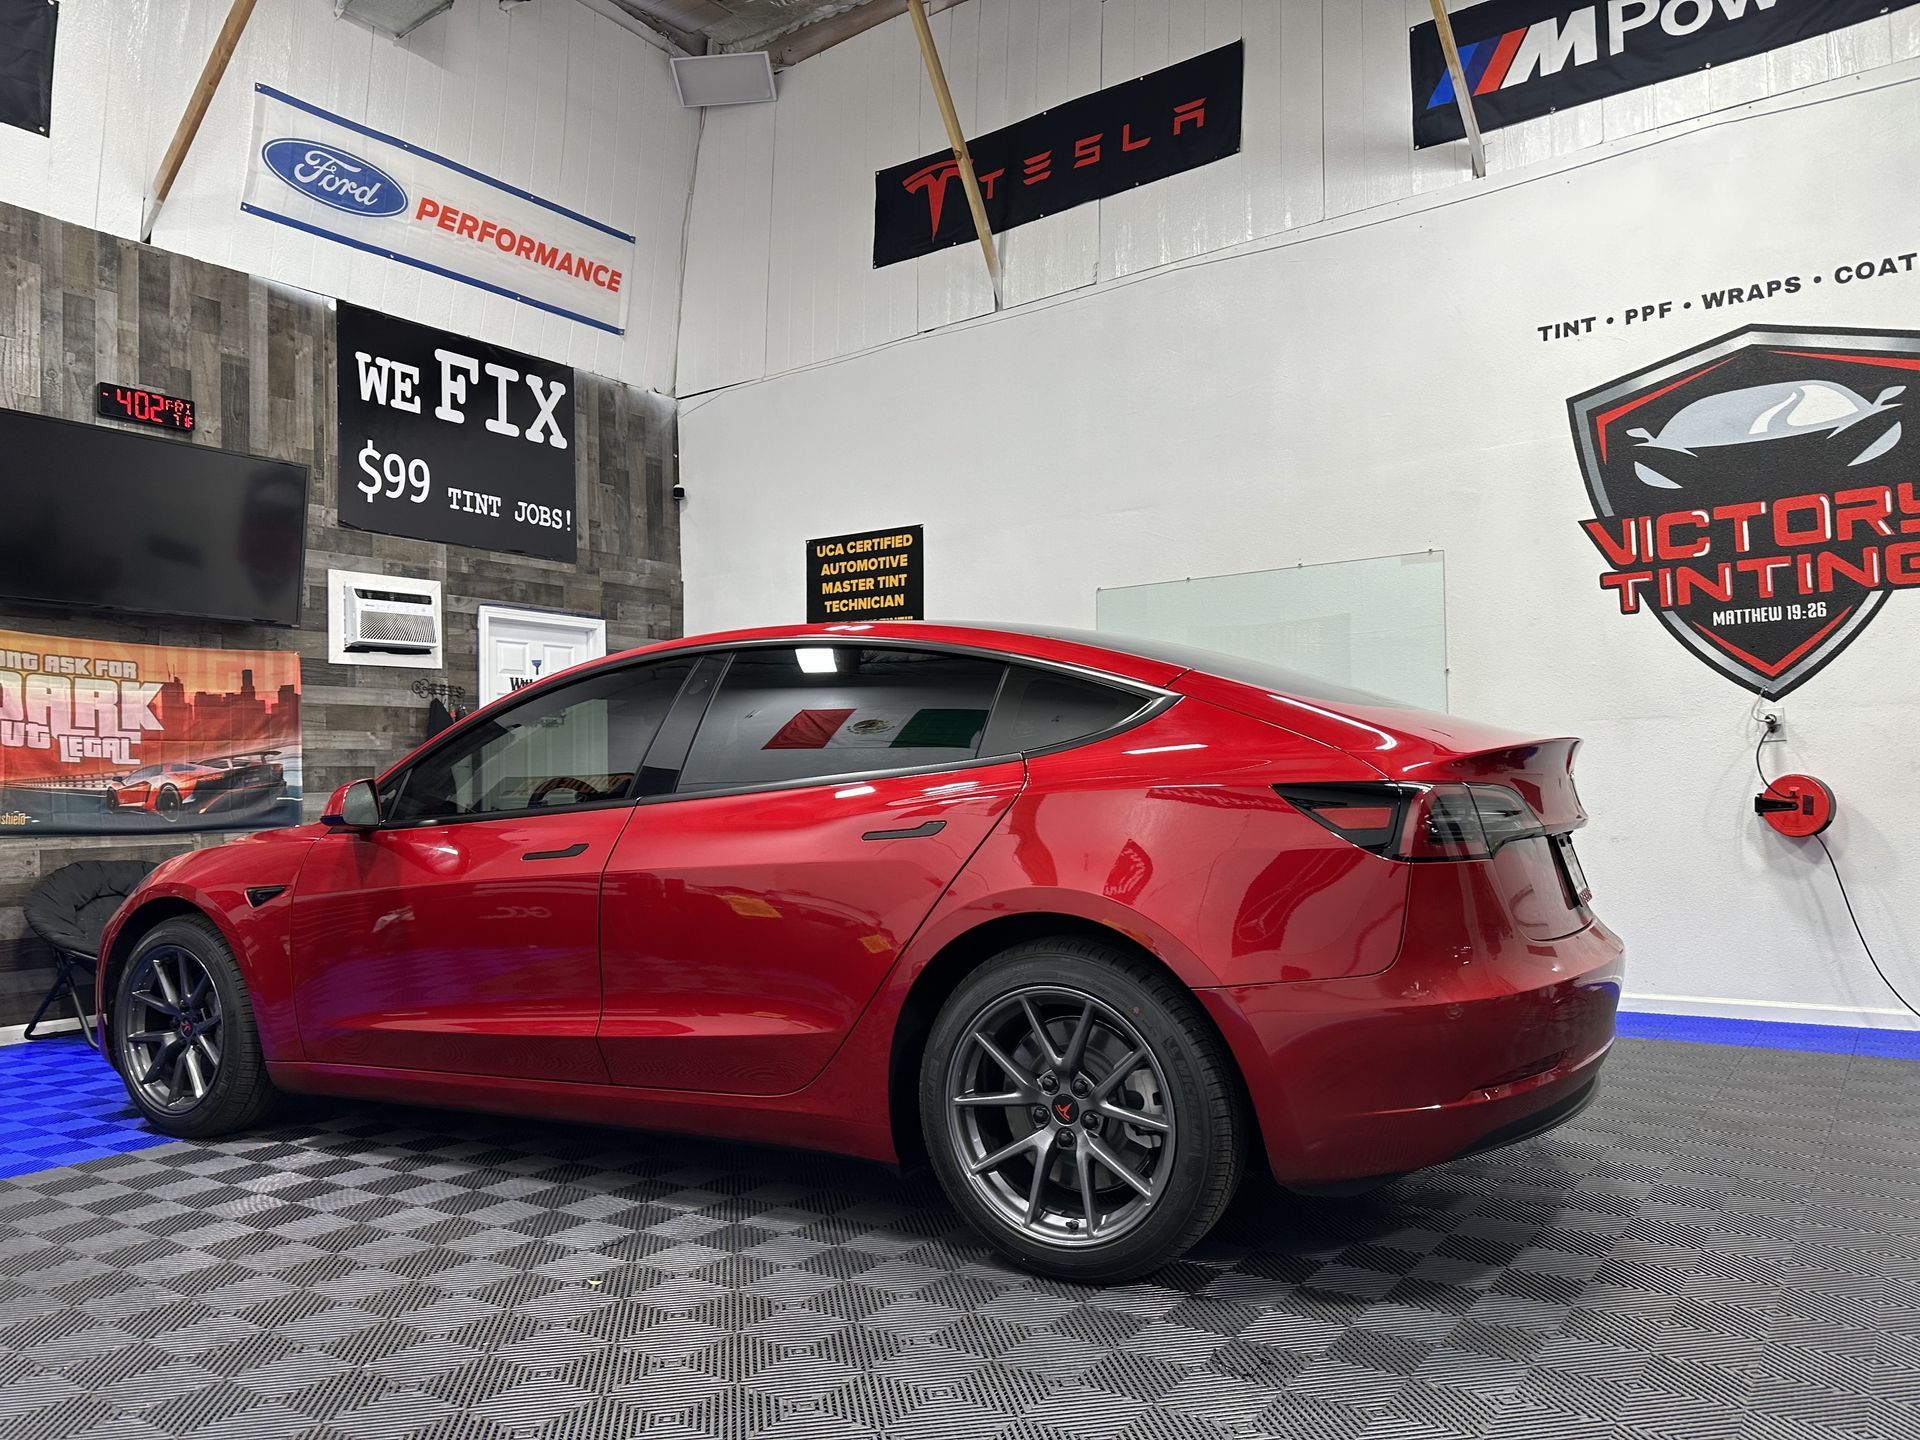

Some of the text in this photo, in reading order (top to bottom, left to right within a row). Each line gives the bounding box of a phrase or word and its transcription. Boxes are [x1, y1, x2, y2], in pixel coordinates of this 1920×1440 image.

[978, 97, 1206, 200] TESLA
[294, 150, 622, 293] Ford PERFORMANCE
[1537, 317, 1596, 342] TINT
[1625, 301, 1673, 325] PPF
[1701, 276, 1802, 310] WRAPS
[355, 348, 568, 450] WE FIX
[357, 439, 571, 531] $99 TINT JOBS!
[816, 534, 913, 558] UCA CERTIFIED
[820, 554, 908, 577] AUTOMOTIVE
[822, 573, 908, 595] MASTER TINT
[824, 593, 905, 613] TECHNICIAN
[1712, 601, 1827, 627] MATTHEW 19:26
[44, 655, 91, 676] ASK
[95, 659, 138, 679] FOR
[59, 735, 141, 765] LEGAL
